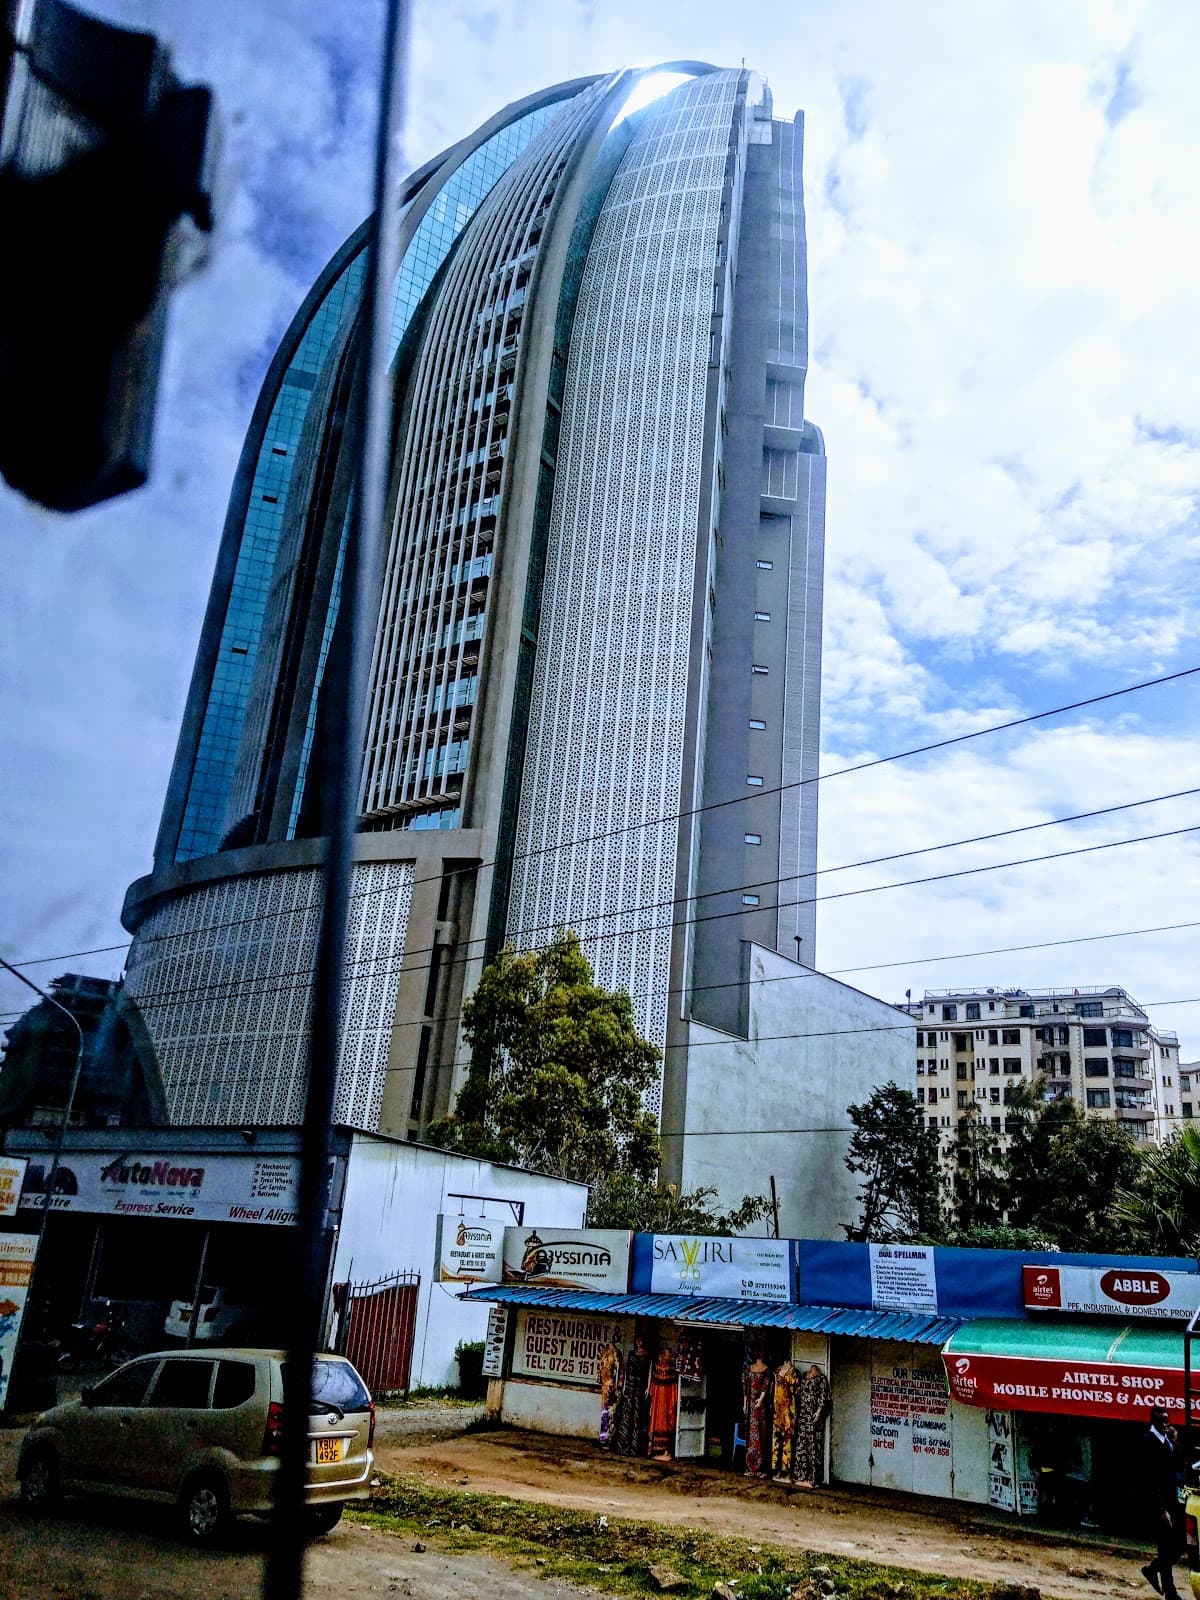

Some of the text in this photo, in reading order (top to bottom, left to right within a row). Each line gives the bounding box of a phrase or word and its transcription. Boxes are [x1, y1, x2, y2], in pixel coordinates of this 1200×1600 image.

[101, 1155, 204, 1187] AutoNova
[115, 1201, 194, 1216] Express Service
[229, 1206, 264, 1220] Wheel
[537, 1249, 611, 1266] ABYSSINIA
[893, 1250, 927, 1260] SPELLMAN
[1032, 1285, 1053, 1294] airtel
[1113, 1278, 1160, 1294] ABBLE
[1067, 1302, 1082, 1311] PPE,
[1083, 1303, 1122, 1313] INDUSTRIAL
[1132, 1306, 1168, 1317] DOMESTIC
[527, 1317, 621, 1343] RESTAURANT &
[526, 1336, 609, 1360] GUEST HOUS
[525, 1354, 546, 1370] TEL:
[549, 1357, 575, 1373] 0725
[578, 1361, 595, 1376] 151
[893, 1367, 908, 1379] OUR
[952, 1374, 979, 1389] airtel
[1062, 1371, 1164, 1391] AIRTEL SHOP
[993, 1383, 1048, 1398] MOBILE
[1051, 1387, 1113, 1404] PHONES
[1116, 1393, 1129, 1404] &
[871, 1414, 902, 1426] WELDING
[912, 1419, 947, 1431] PLUMBING
[871, 1425, 899, 1439] Safcom
[319, 1439, 334, 1450] KBU
[873, 1437, 895, 1450] airtel
[319, 1449, 339, 1461] 492F
